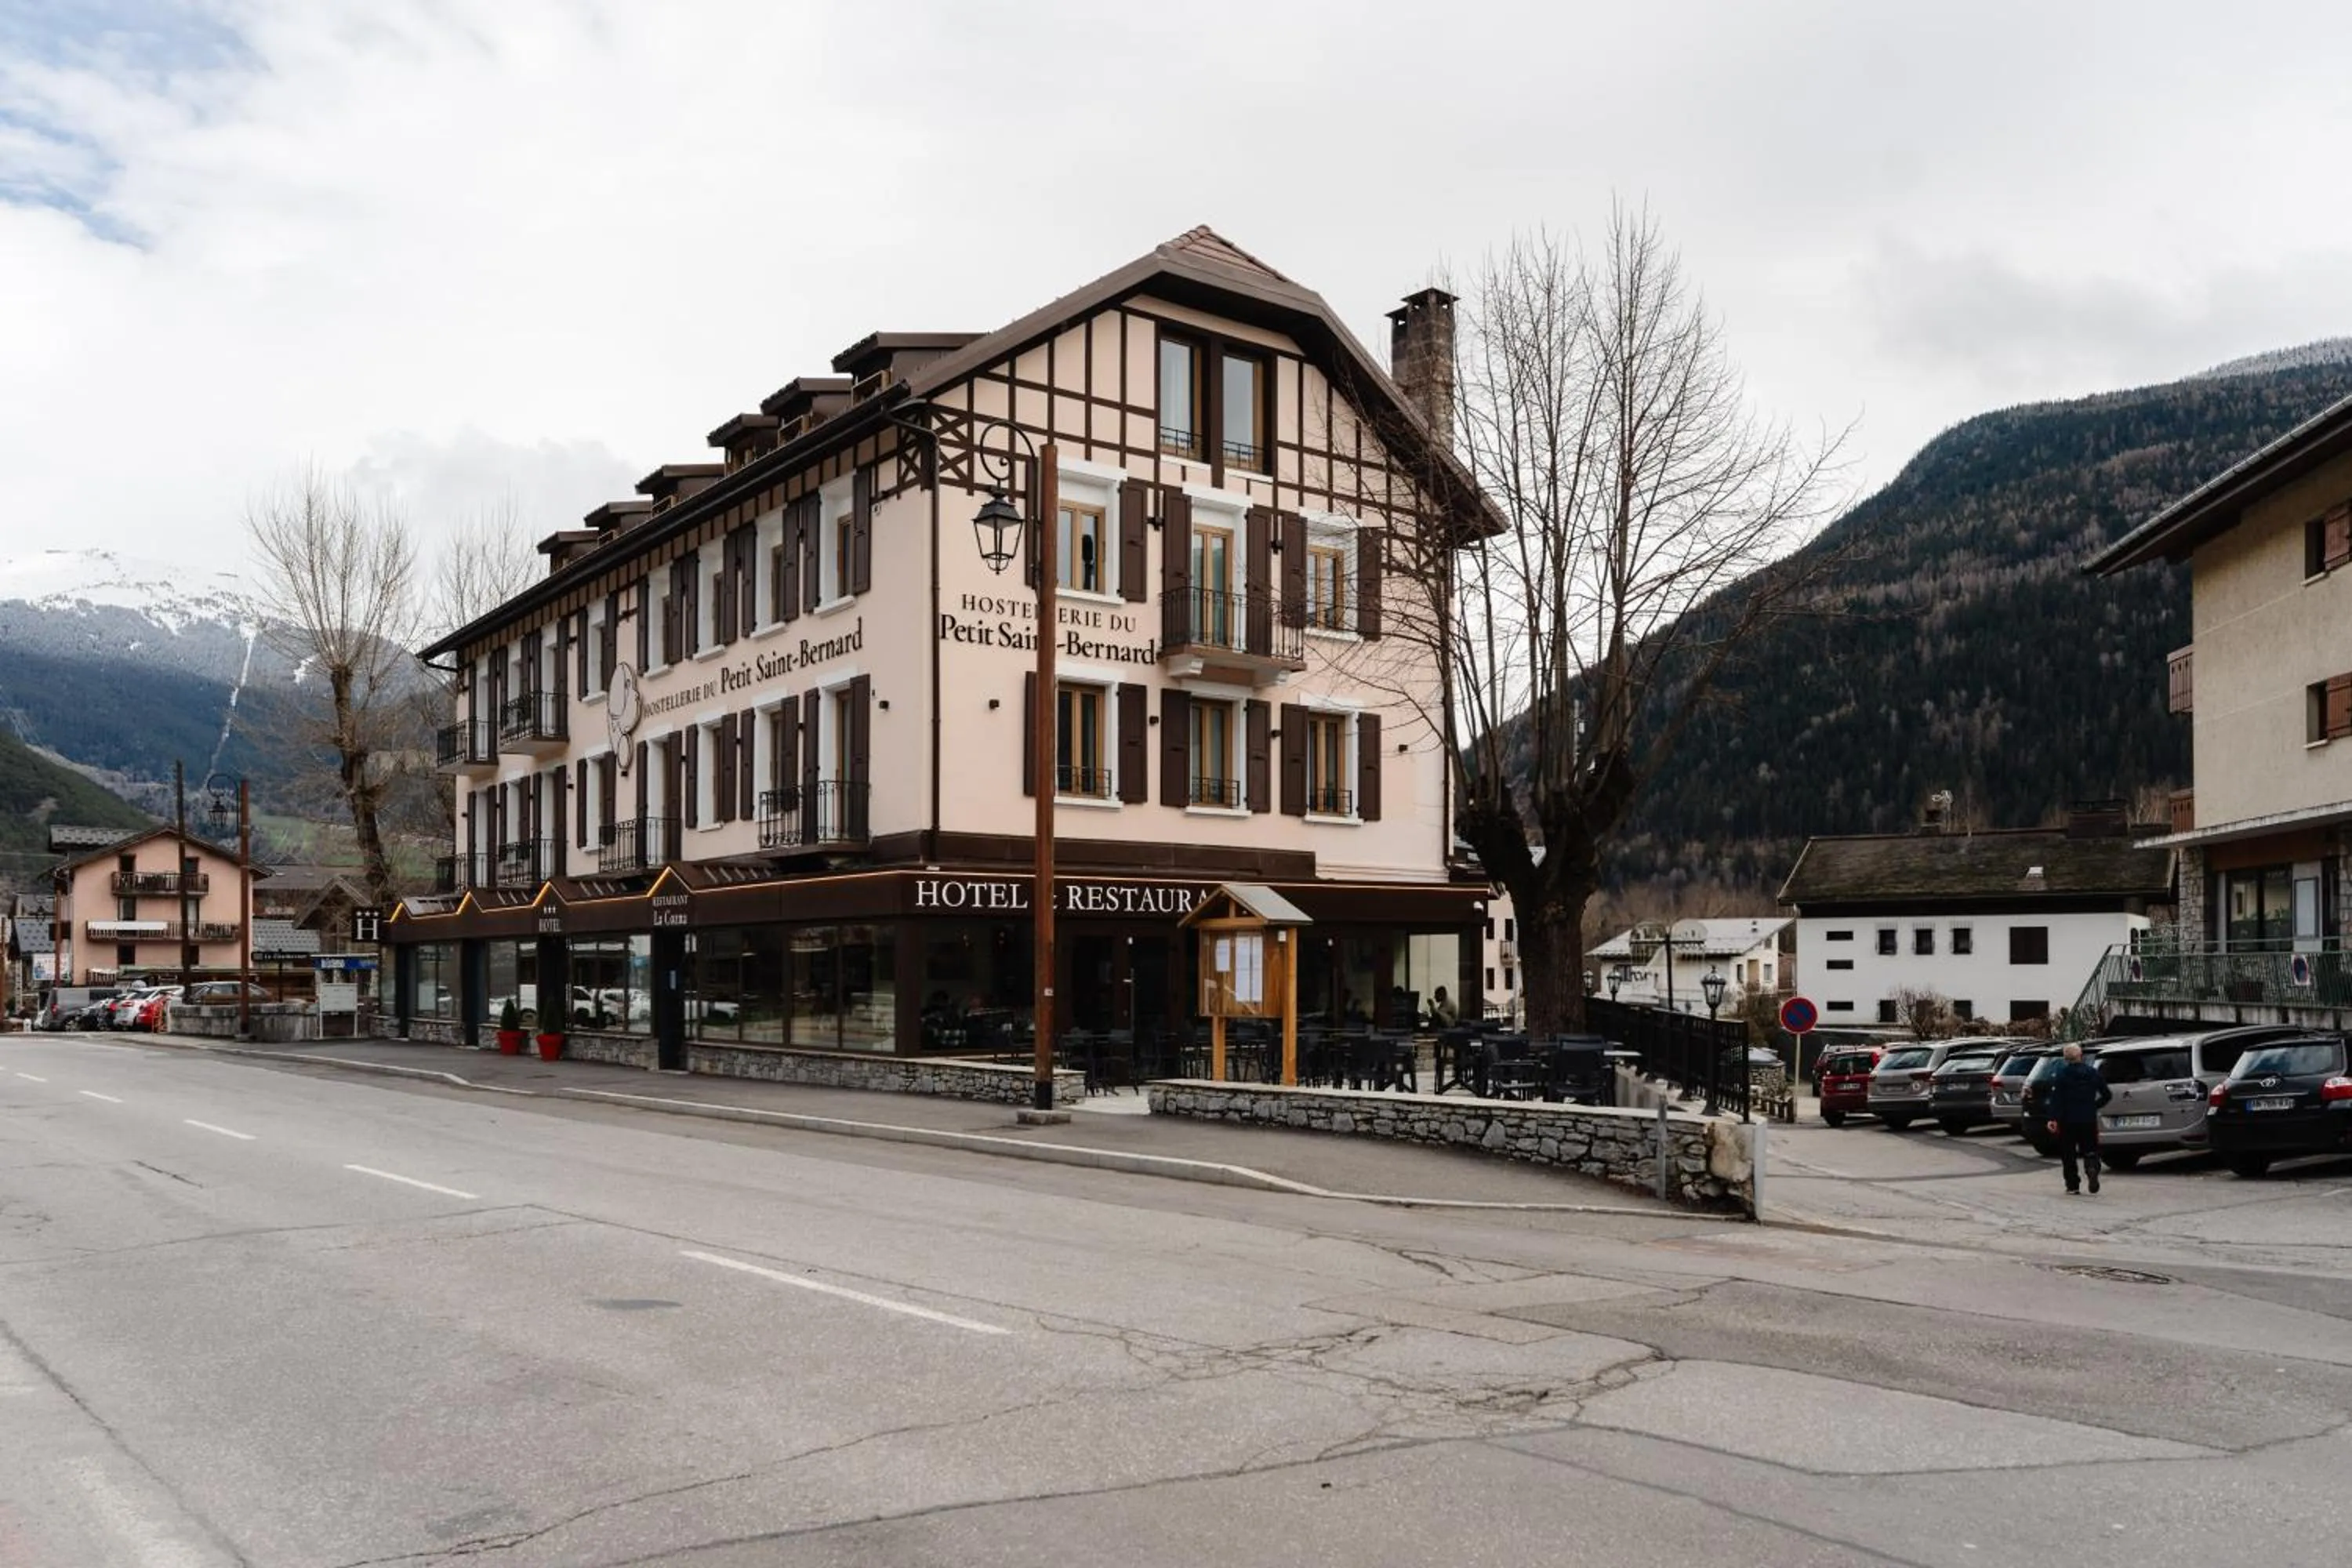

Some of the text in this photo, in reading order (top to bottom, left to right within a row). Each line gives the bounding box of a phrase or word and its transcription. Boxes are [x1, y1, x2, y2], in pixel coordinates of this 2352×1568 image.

[961, 593, 1137, 633] HOSTEERIE DU
[940, 614, 1156, 666] Petit Sai-Bernard
[644, 617, 863, 719] HOSTELLERIE DU Petit Saint-Bernard
[915, 880, 1029, 909] HOTEL
[1065, 885, 1208, 913] RESTAURA
[355, 918, 379, 940] H
